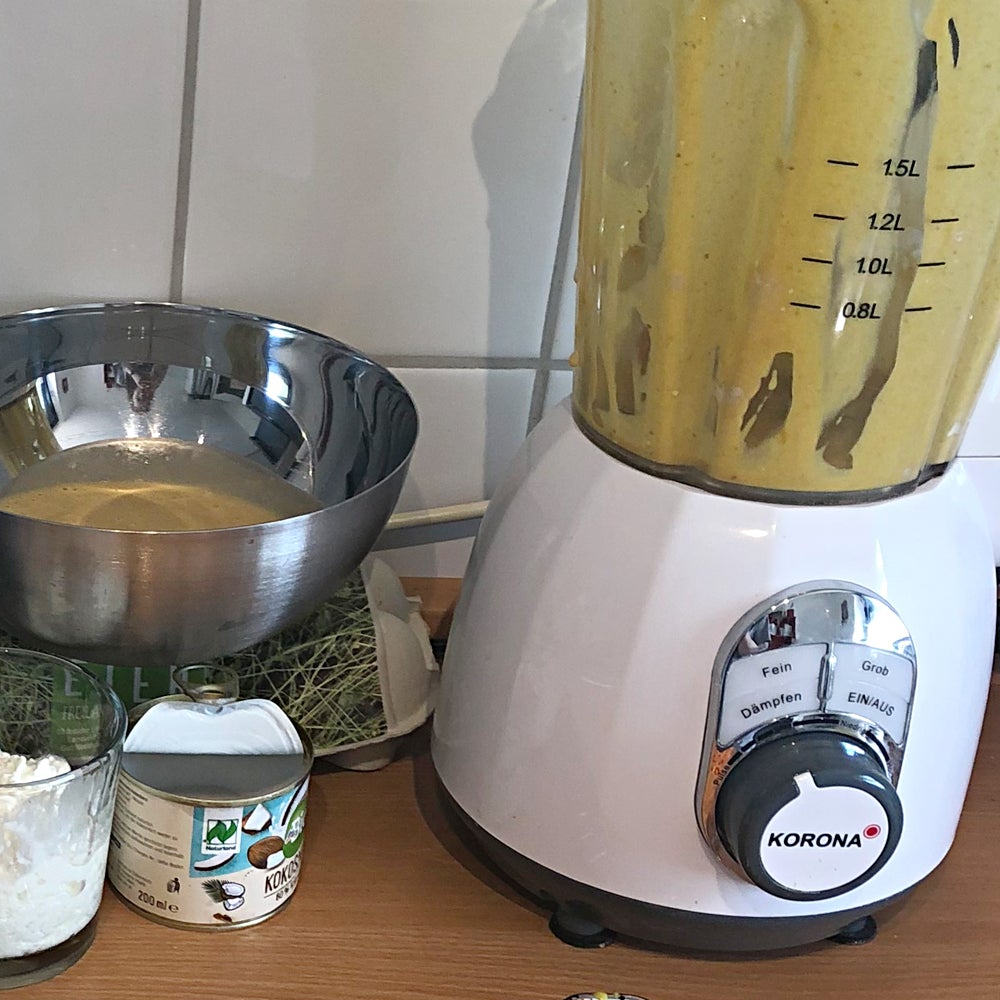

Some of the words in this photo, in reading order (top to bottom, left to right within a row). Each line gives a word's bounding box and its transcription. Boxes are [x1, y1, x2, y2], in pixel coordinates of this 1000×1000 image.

[882, 158, 921, 177] 1.5L
[867, 213, 906, 231] 1.2L
[855, 257, 893, 275] 1.0L
[842, 302, 881, 319] 0.8L
[761, 661, 793, 679] Fein
[861, 660, 890, 678] Grob
[740, 692, 803, 720] Dämpfen
[847, 691, 896, 718] EIN/AUS
[767, 831, 862, 848] KORONA
[137, 889, 155, 906] 200
[156, 900, 167, 911] ml
